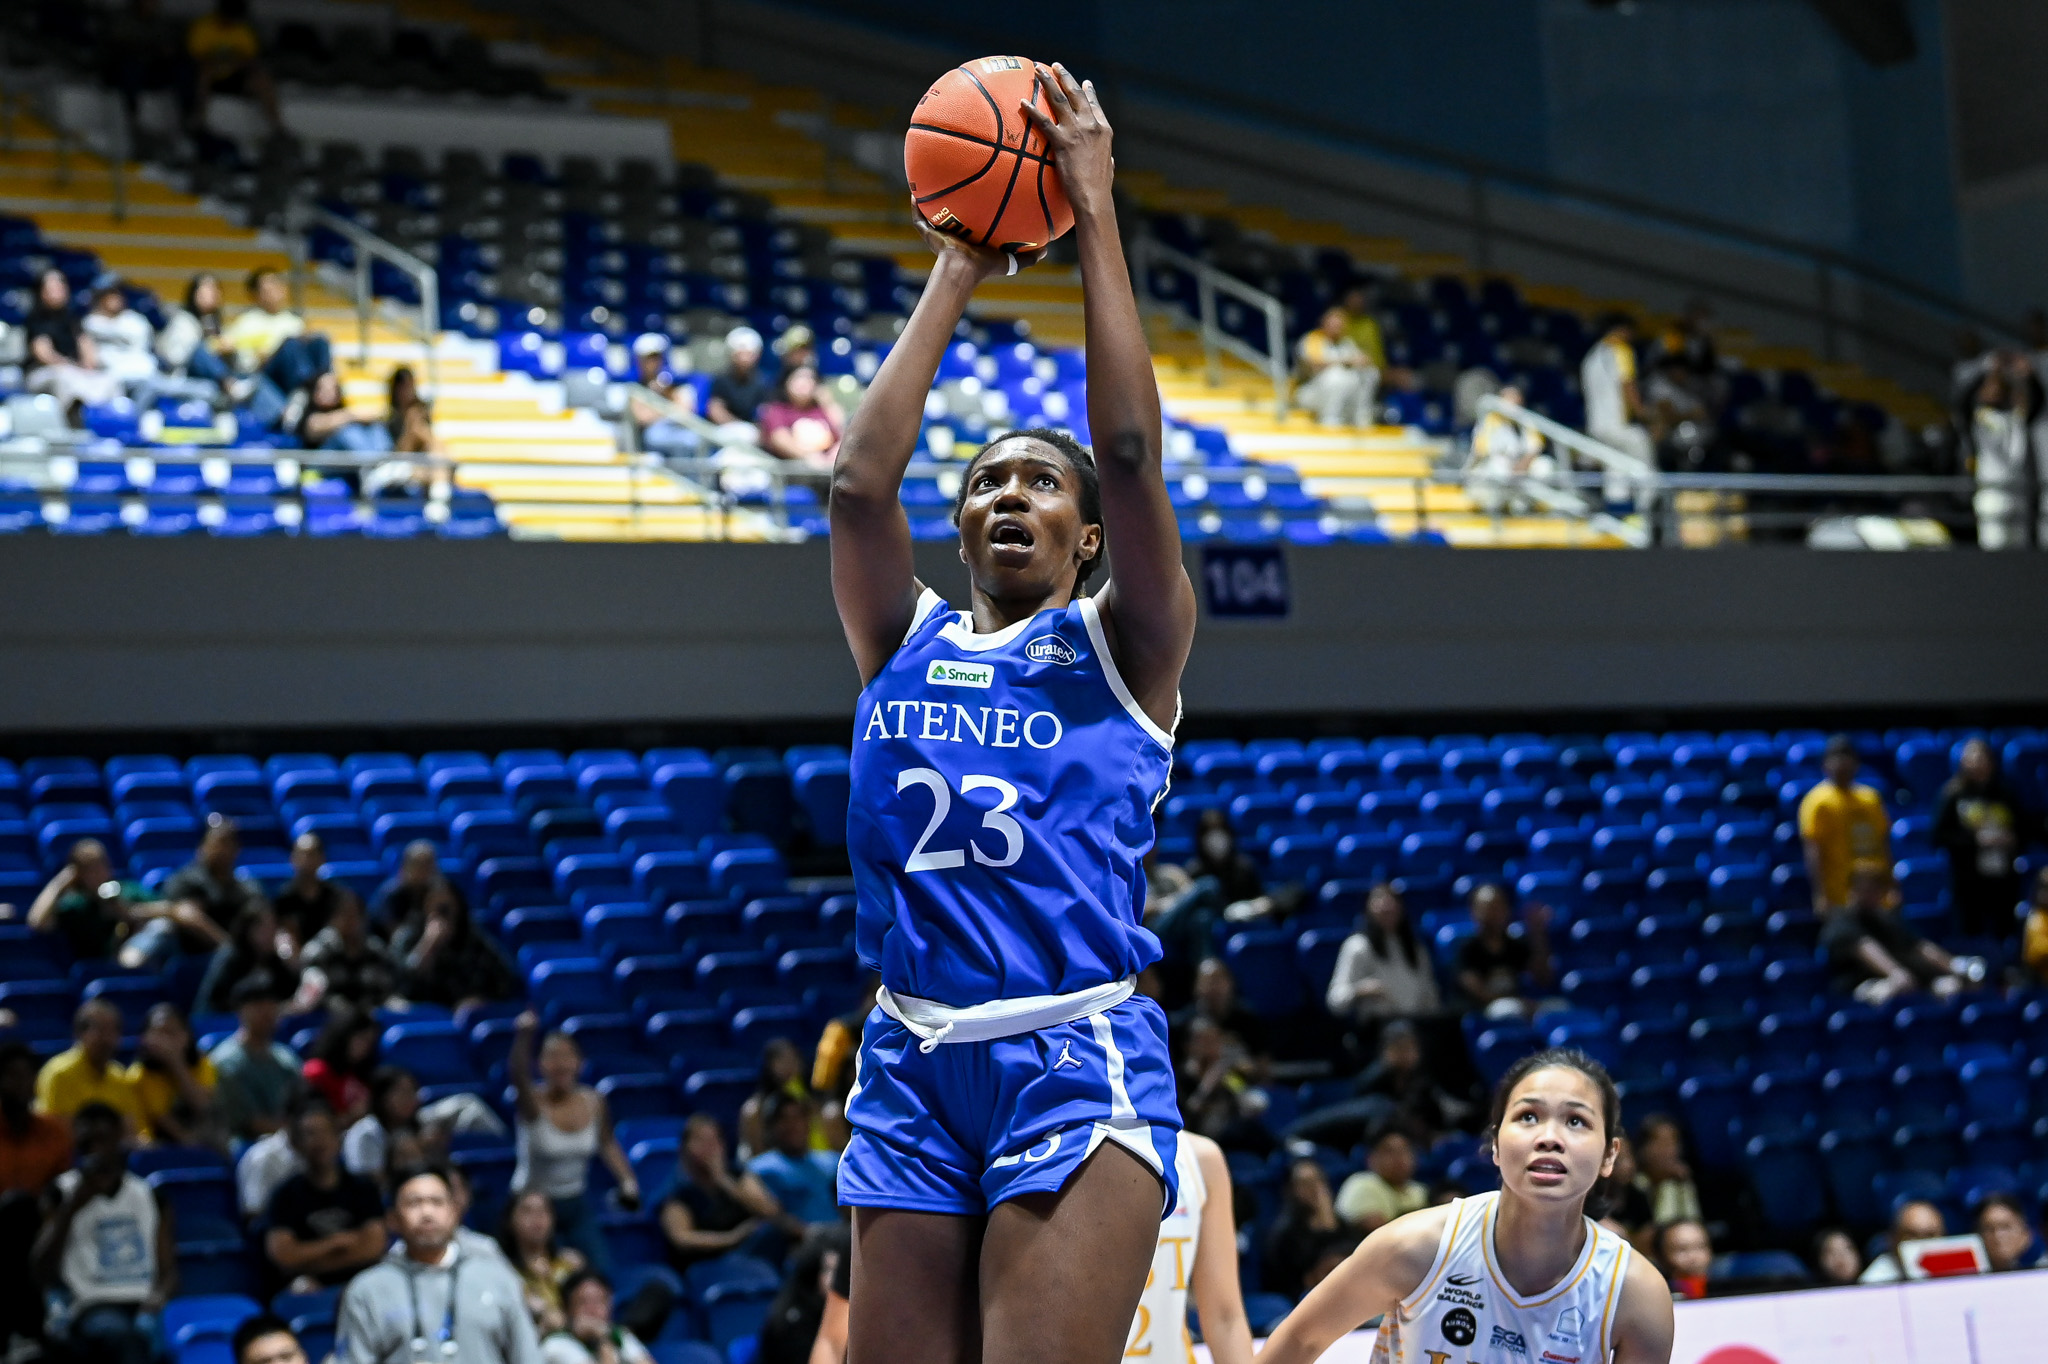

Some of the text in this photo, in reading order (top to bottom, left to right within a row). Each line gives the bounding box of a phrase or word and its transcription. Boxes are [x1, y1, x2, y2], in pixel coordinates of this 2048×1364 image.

[1205, 559, 1282, 603] 104
[948, 668, 988, 684] Smart
[863, 700, 1063, 749] ATENEO
[896, 767, 1024, 873] 23
[1444, 1287, 1481, 1300] WORLD
[1437, 1294, 1485, 1310] BALANCE
[1445, 1320, 1474, 1334] AURORA
